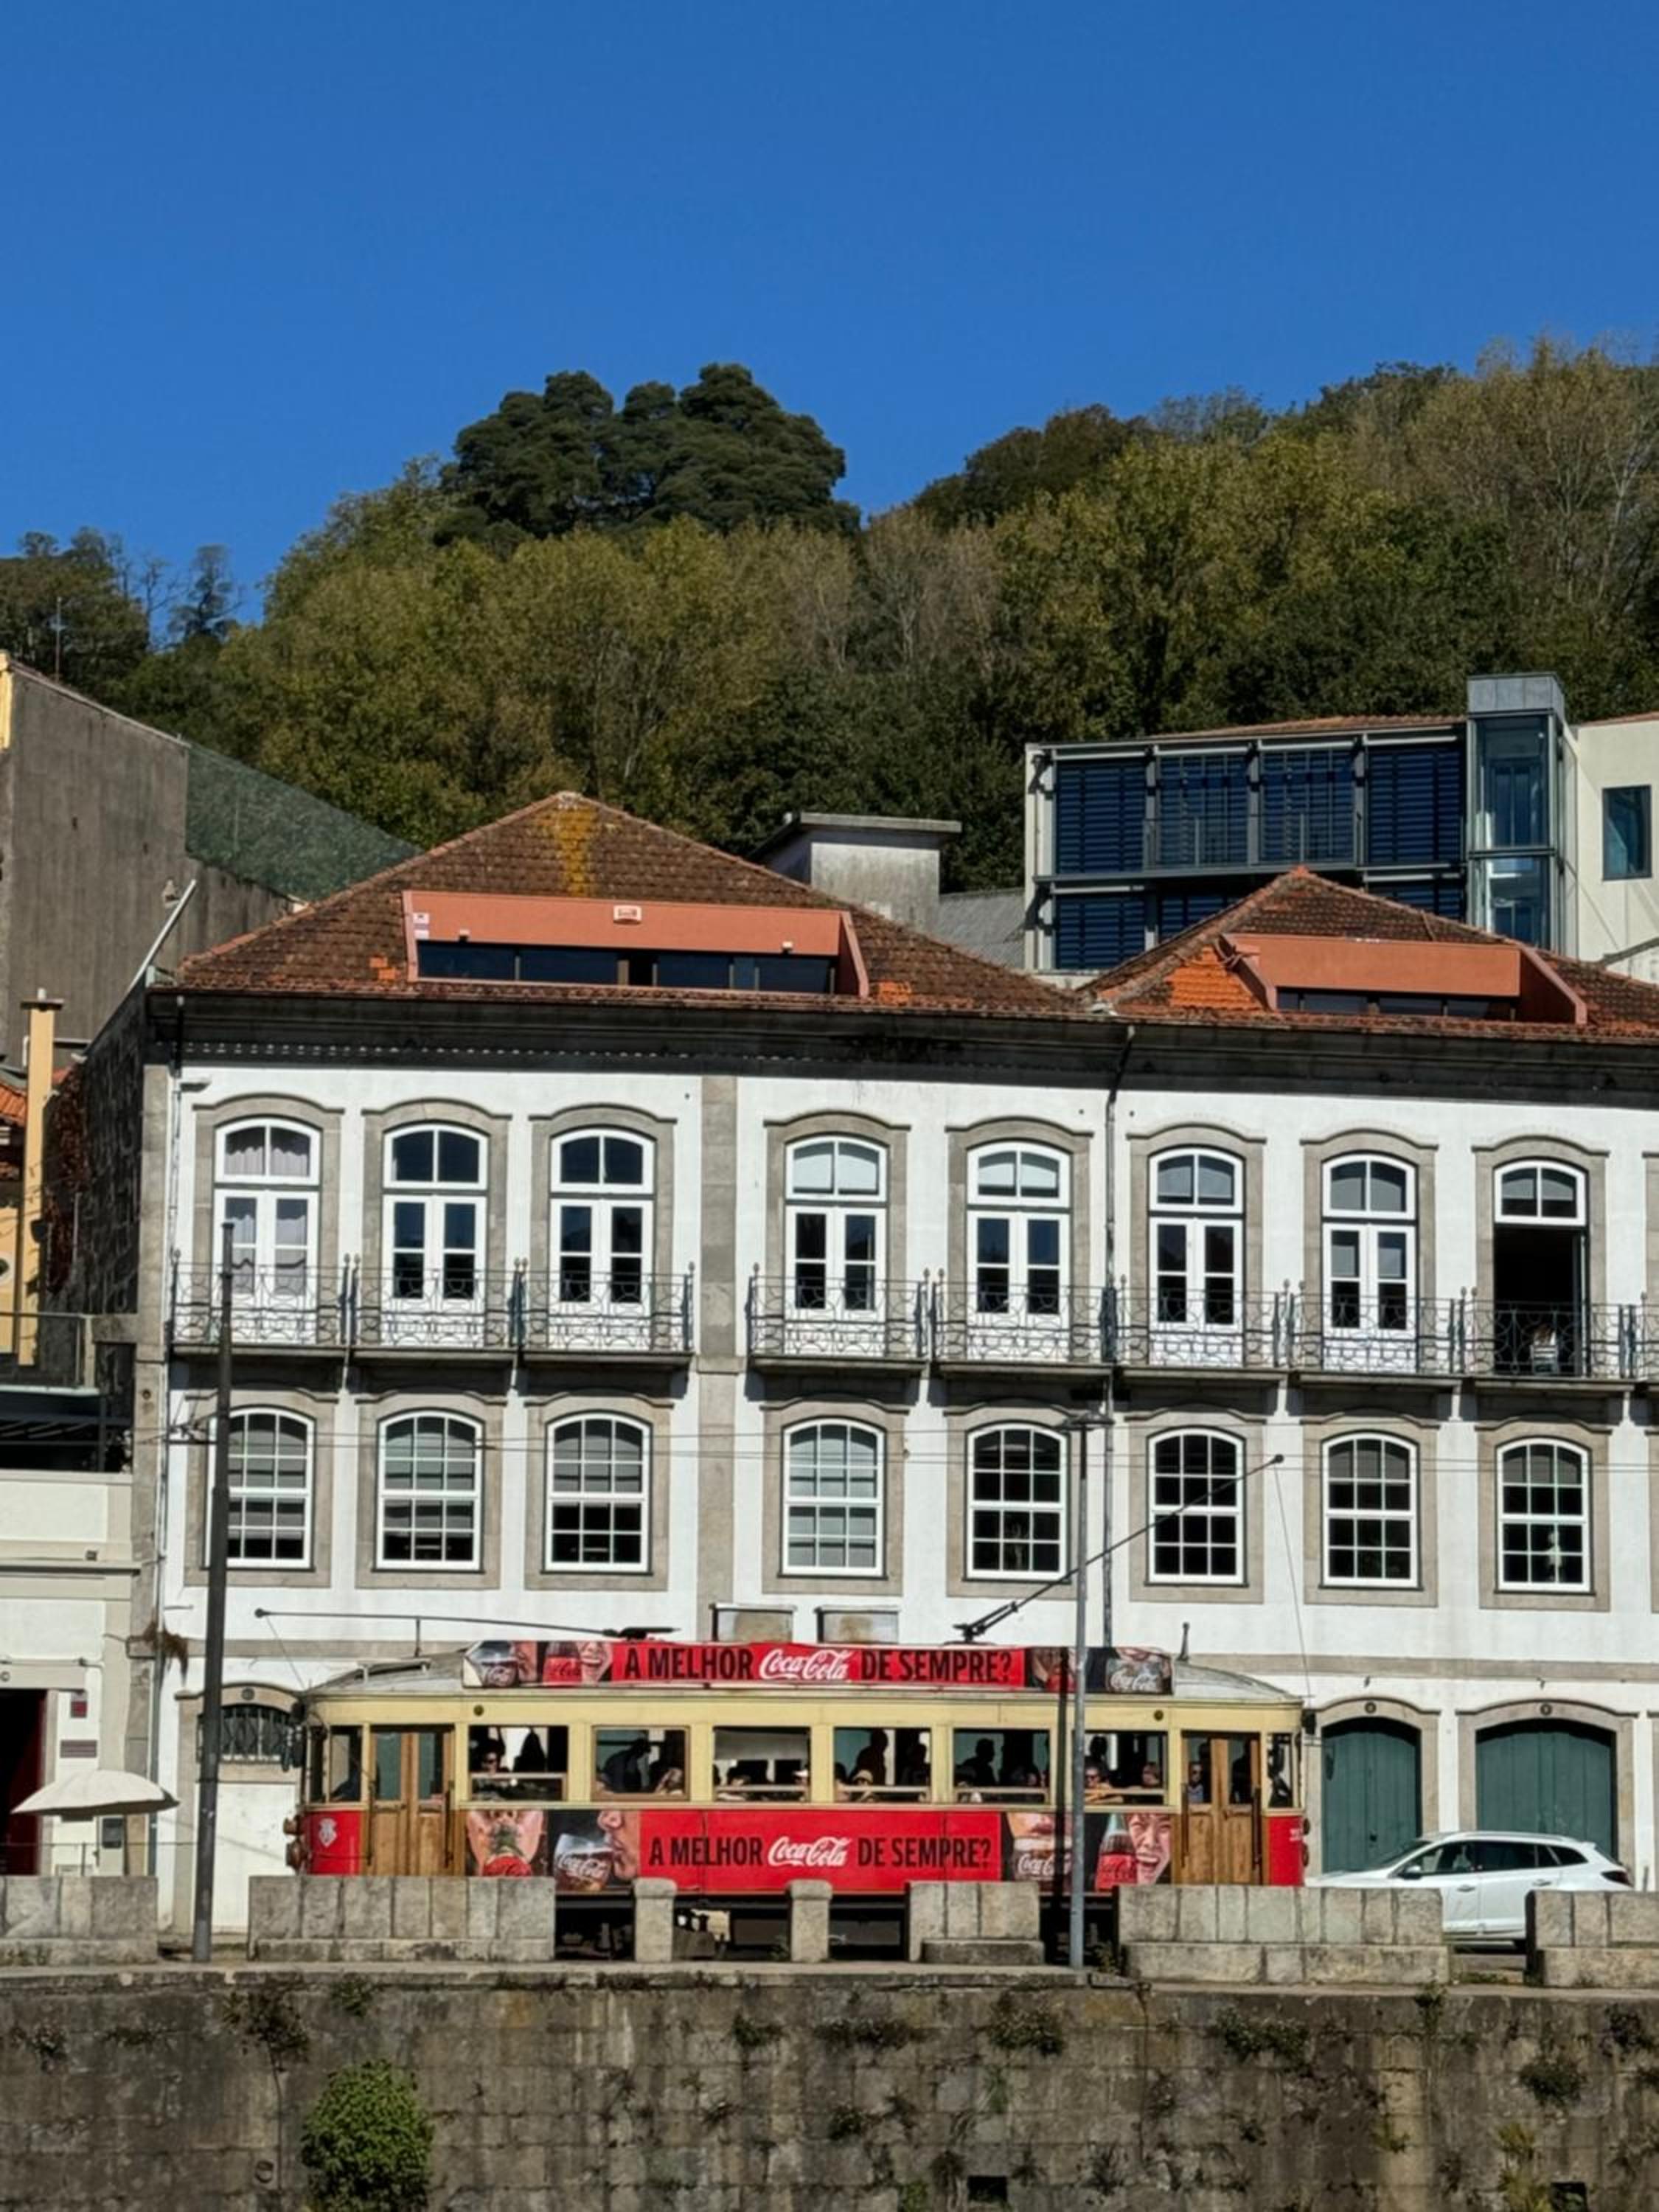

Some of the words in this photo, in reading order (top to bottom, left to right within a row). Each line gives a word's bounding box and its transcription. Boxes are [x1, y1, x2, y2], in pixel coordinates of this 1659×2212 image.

[626, 1649, 641, 1680] A
[648, 1648, 754, 1680] MELHOR
[861, 1649, 894, 1682] DE
[900, 1649, 1012, 1683] SEMPRE?
[650, 1837, 664, 1866] A
[671, 1837, 764, 1867] MELHOR
[858, 1837, 884, 1868] DE
[891, 1837, 992, 1869] SEMPRE?
